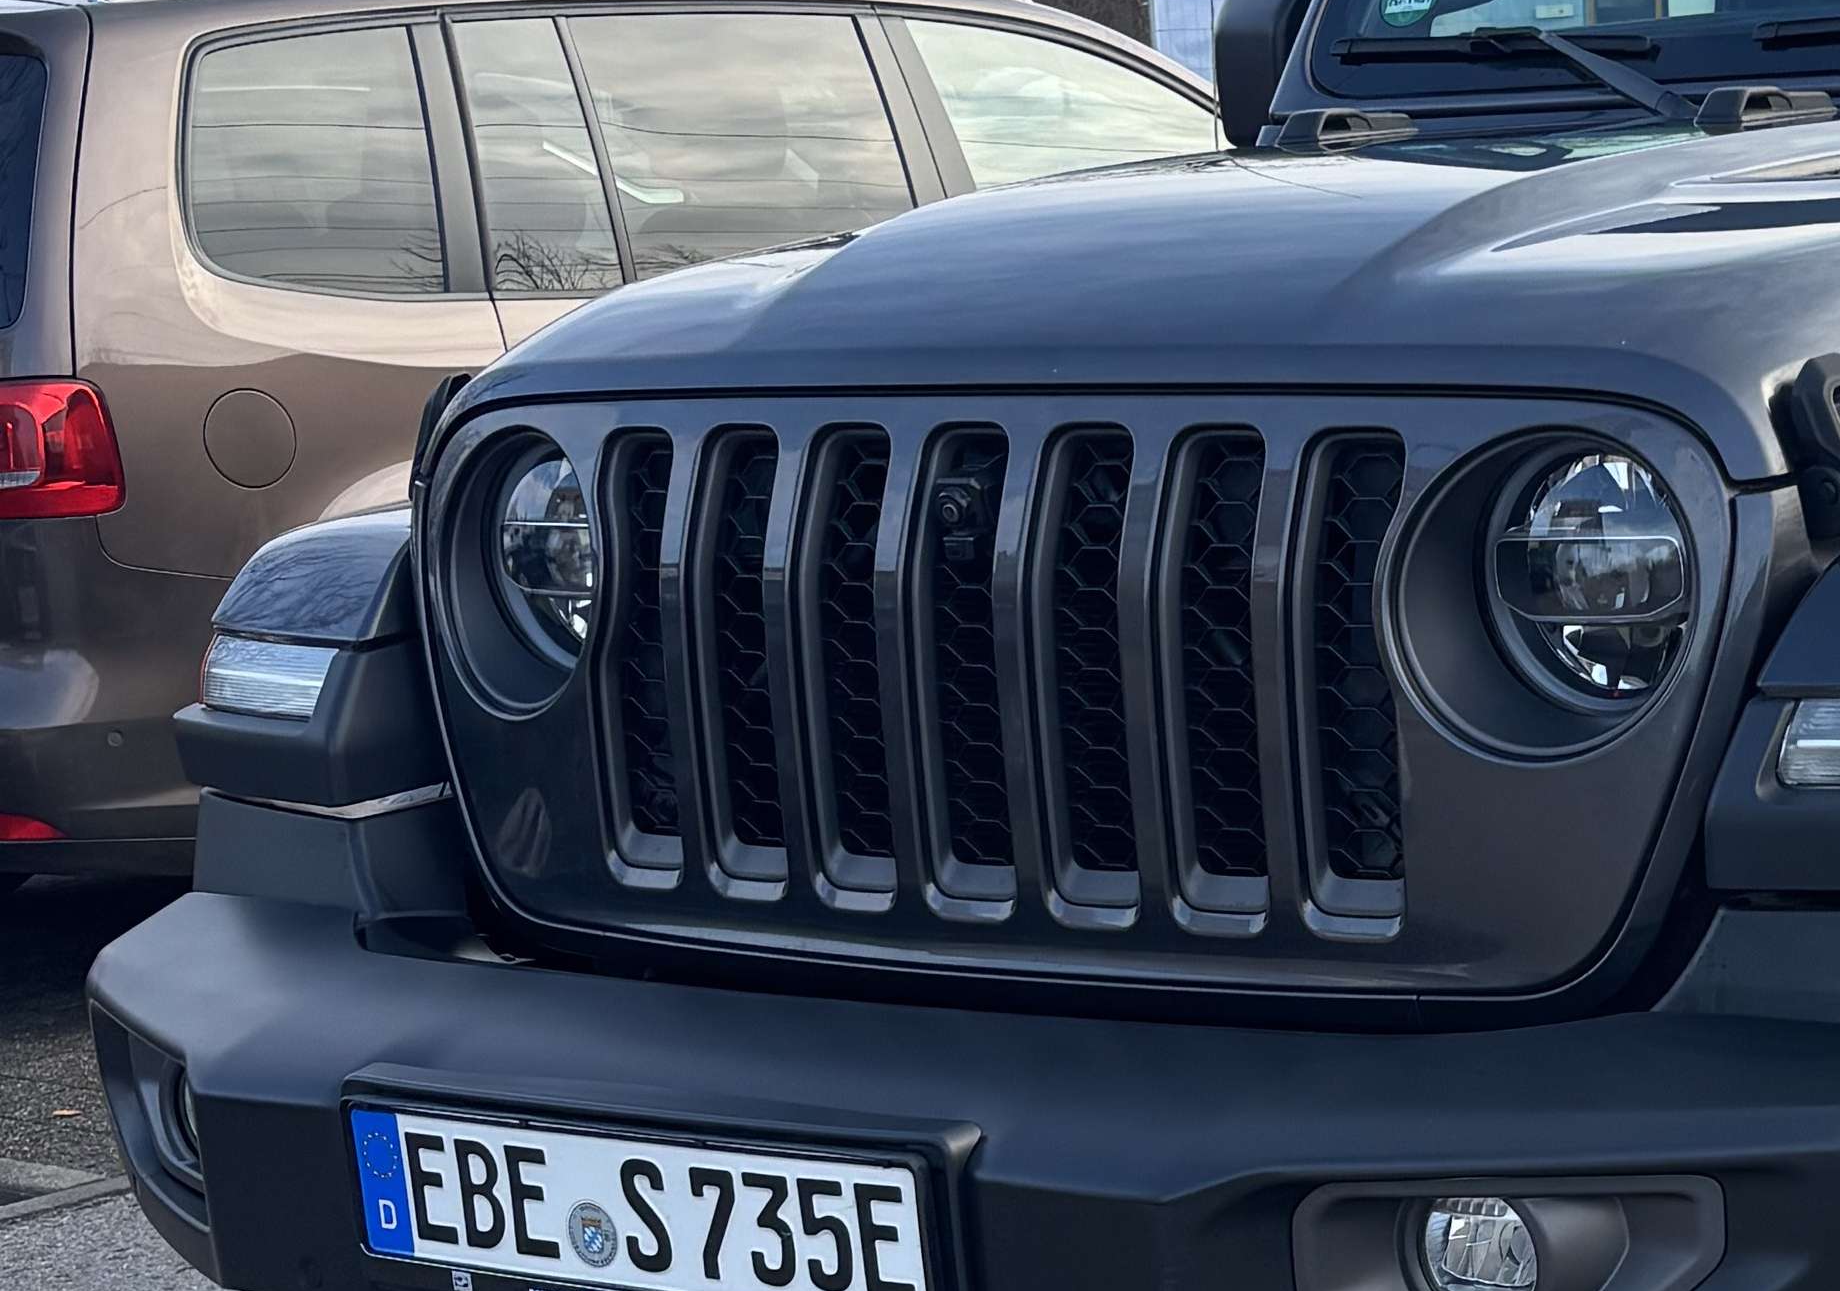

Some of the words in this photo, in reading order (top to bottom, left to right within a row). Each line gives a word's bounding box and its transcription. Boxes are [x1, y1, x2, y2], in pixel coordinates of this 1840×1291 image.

[378, 1198, 398, 1230] D
[404, 1131, 560, 1259] EBE
[619, 1158, 673, 1273] S
